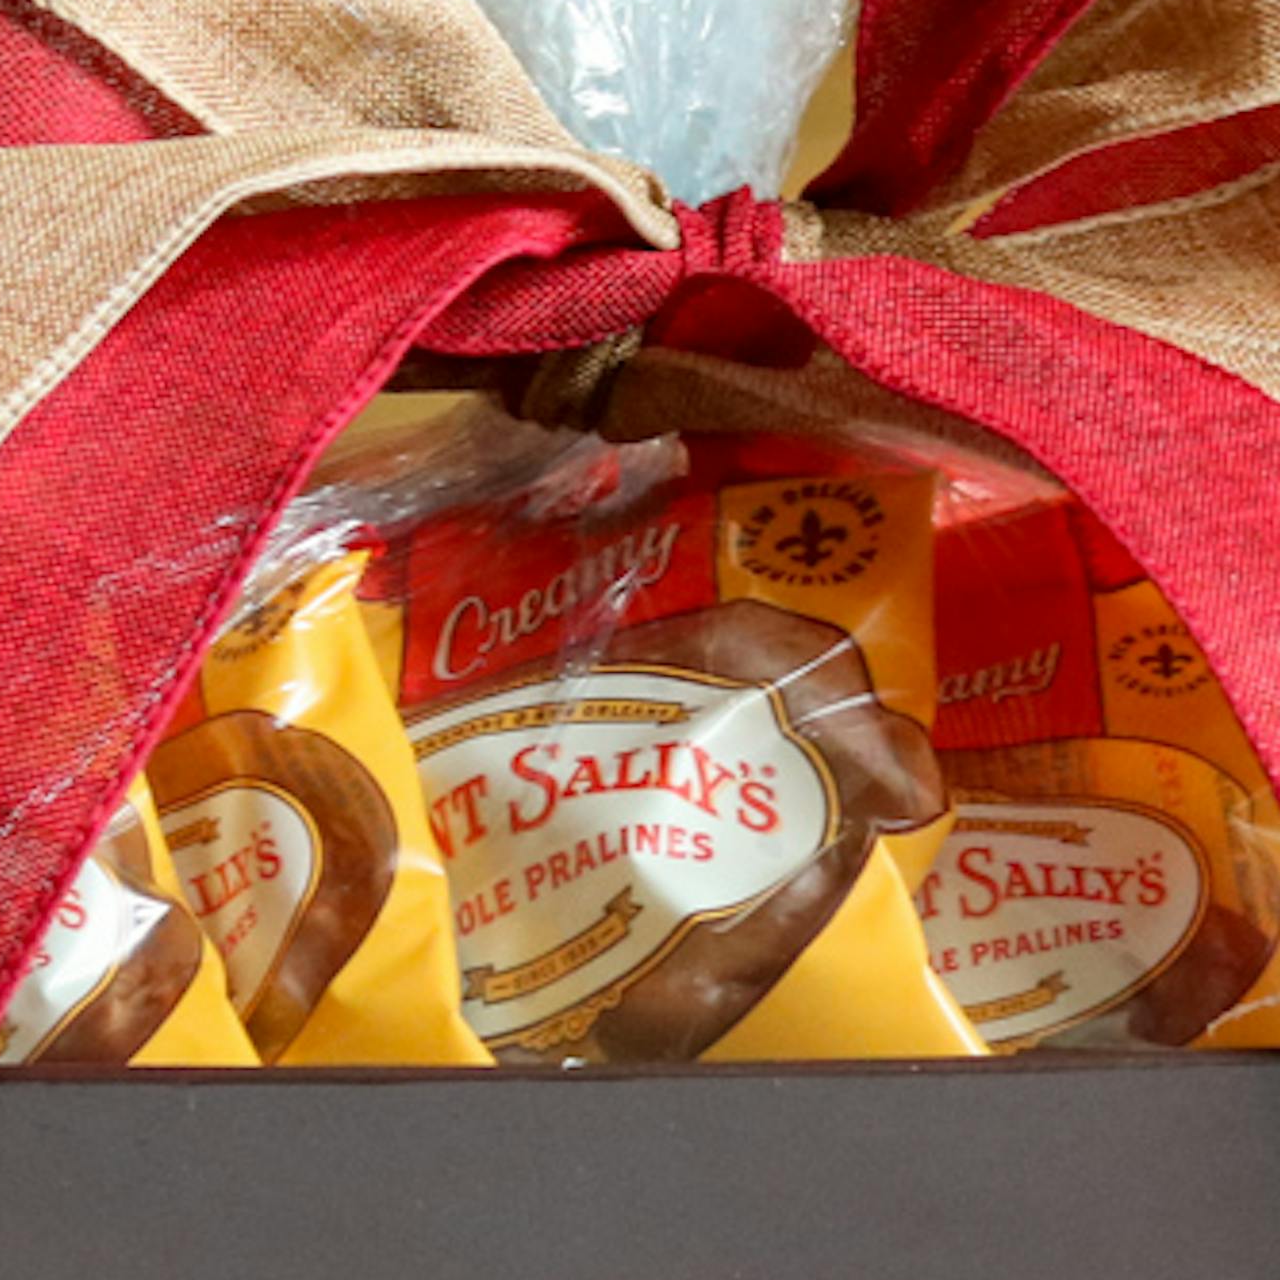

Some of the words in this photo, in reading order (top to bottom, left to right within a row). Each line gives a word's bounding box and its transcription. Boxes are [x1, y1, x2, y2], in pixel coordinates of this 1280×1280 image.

[433, 523, 680, 681] Creamy
[937, 642, 1061, 704] amy
[429, 773, 489, 860] NT
[455, 880, 516, 937] OLE
[523, 823, 715, 902] PRALINES
[972, 920, 1125, 966] PRALINES
